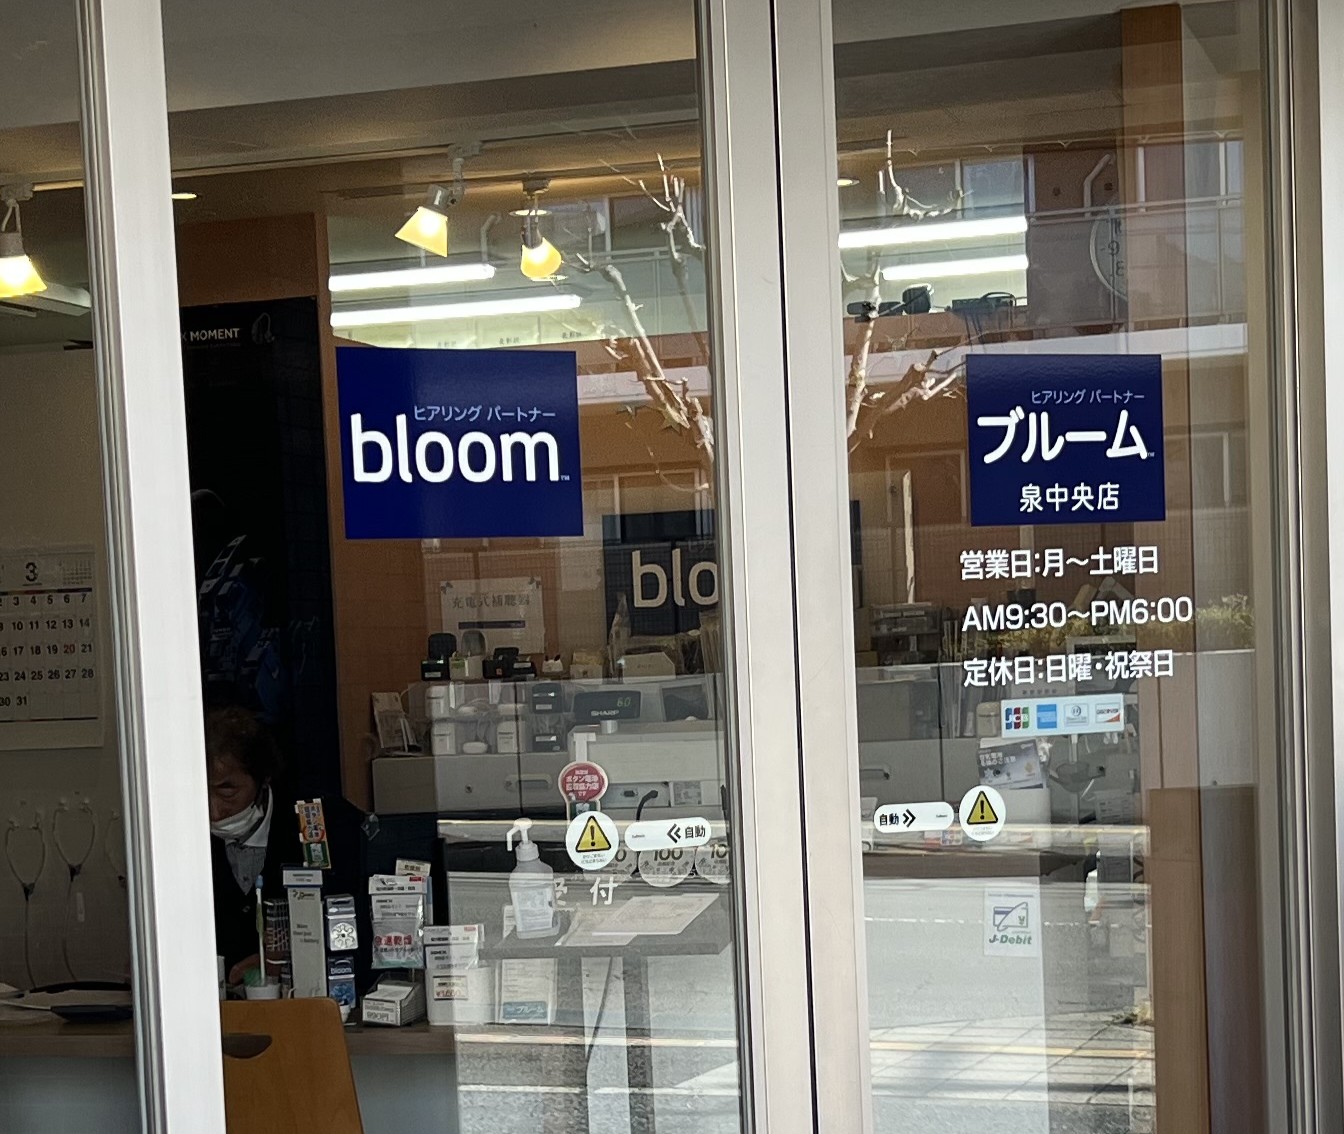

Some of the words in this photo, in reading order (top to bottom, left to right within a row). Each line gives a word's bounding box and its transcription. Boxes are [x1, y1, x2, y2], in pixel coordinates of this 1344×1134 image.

[189, 328, 240, 342] MOMENT
[1031, 389, 1086, 404] ヒアリング
[1089, 389, 1145, 404] パートナー
[414, 405, 482, 421] ヒアリング
[487, 405, 556, 422] パートナー
[977, 405, 1148, 464] ブルーム
[350, 413, 559, 483] bloom
[1019, 482, 1120, 513] 泉中央店
[25, 562, 38, 582] 3
[591, 709, 619, 717] SHARP
[879, 813, 899, 827] 自動
[684, 825, 706, 839] 自動
[988, 934, 1032, 945] J-Debit
